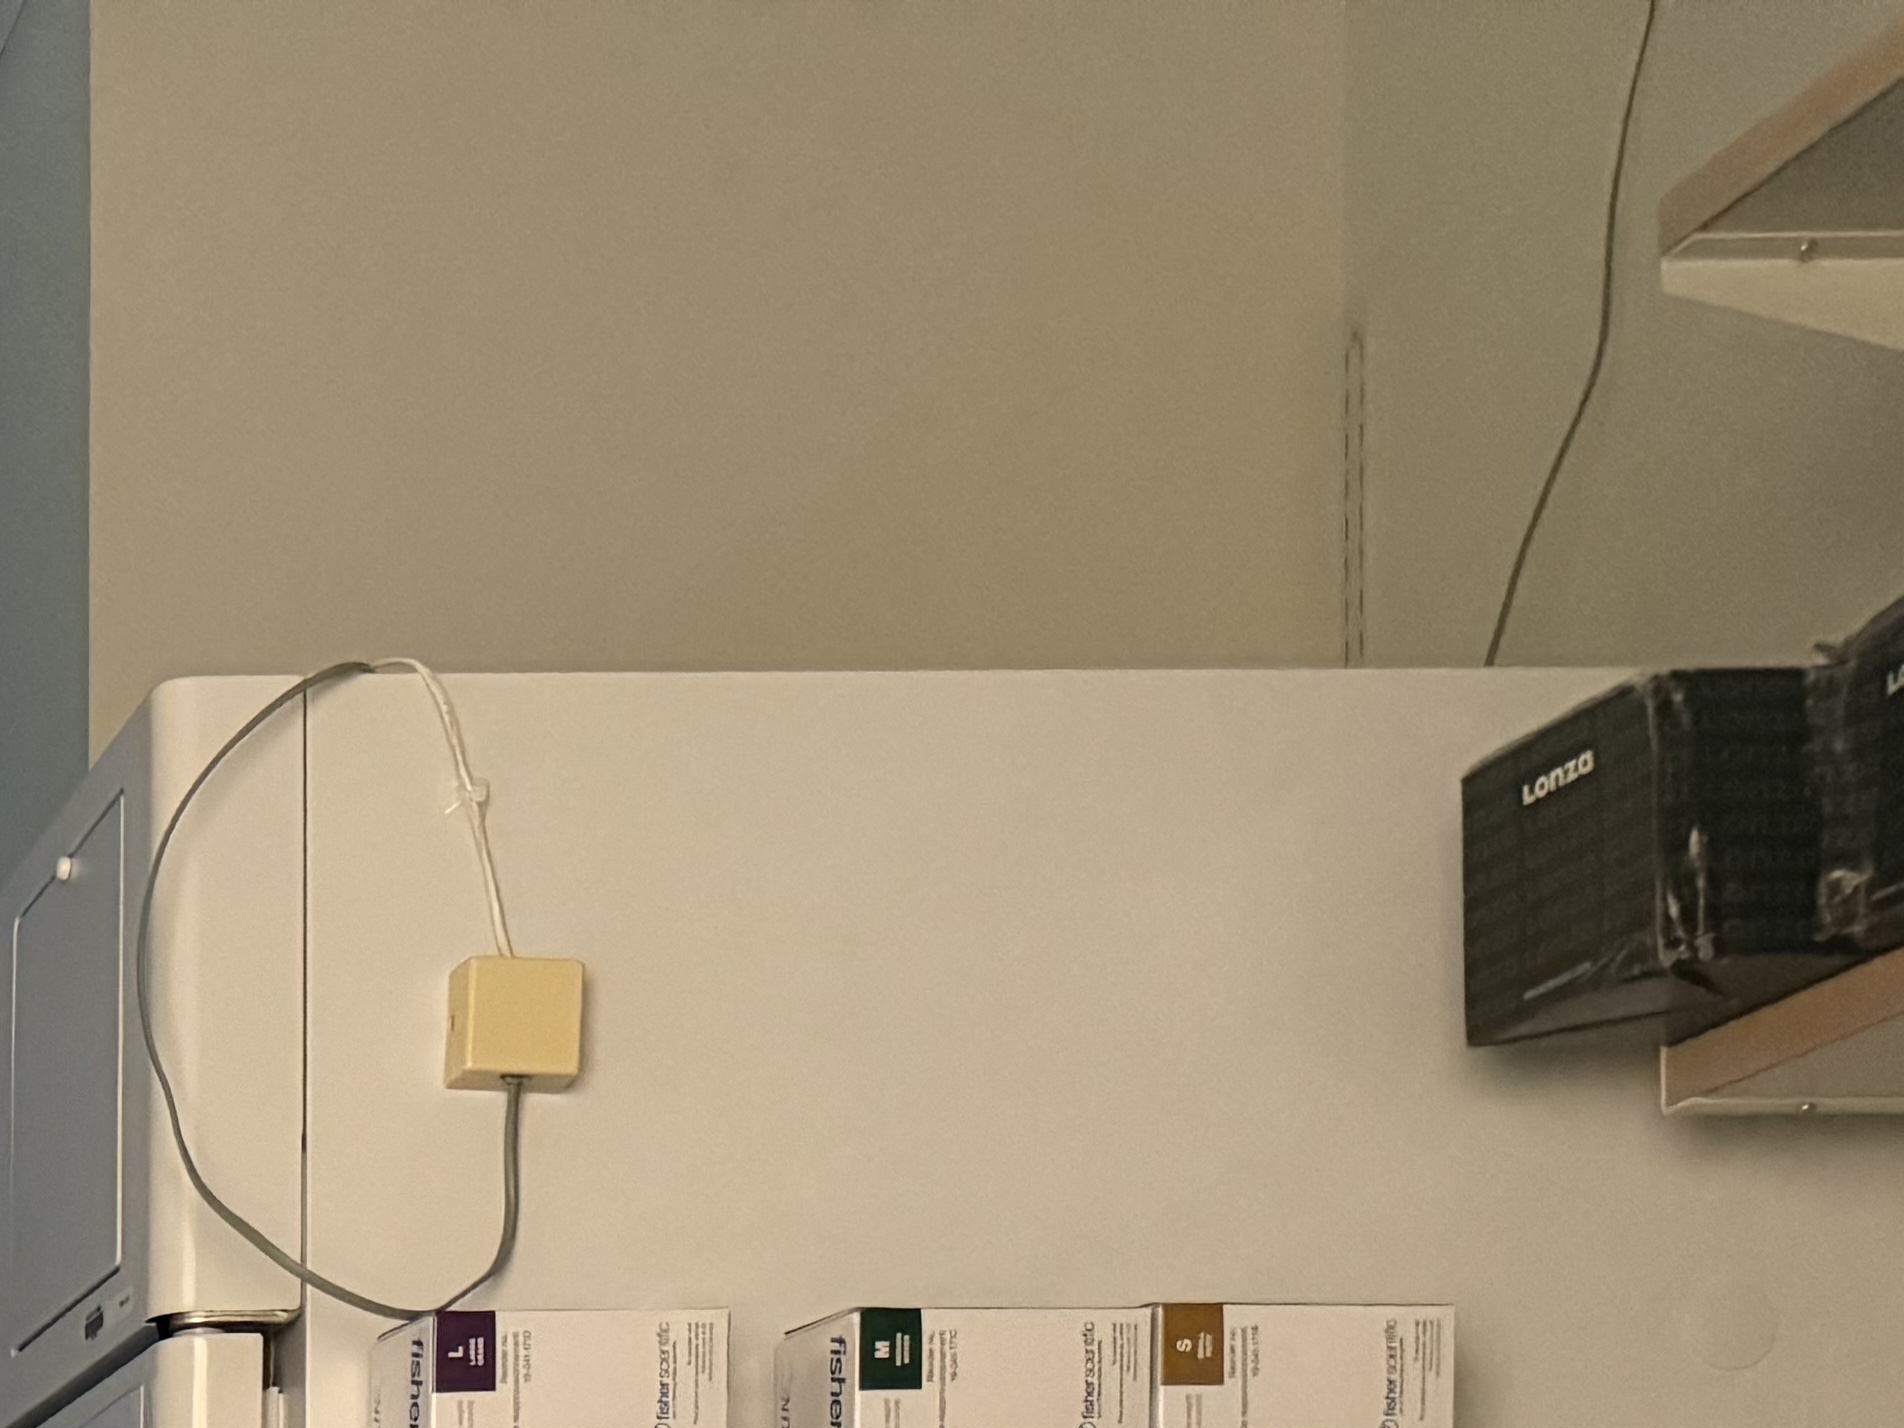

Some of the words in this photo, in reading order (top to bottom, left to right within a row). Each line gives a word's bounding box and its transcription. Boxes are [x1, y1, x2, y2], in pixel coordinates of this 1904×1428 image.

[1522, 749, 1594, 806] Lonza
[448, 1346, 463, 1358] L
[874, 1341, 890, 1358] M
[1176, 1339, 1192, 1352] S
[657, 1381, 670, 1420] fisher
[1081, 1379, 1095, 1420] fisher
[1383, 1377, 1397, 1417] fisher
